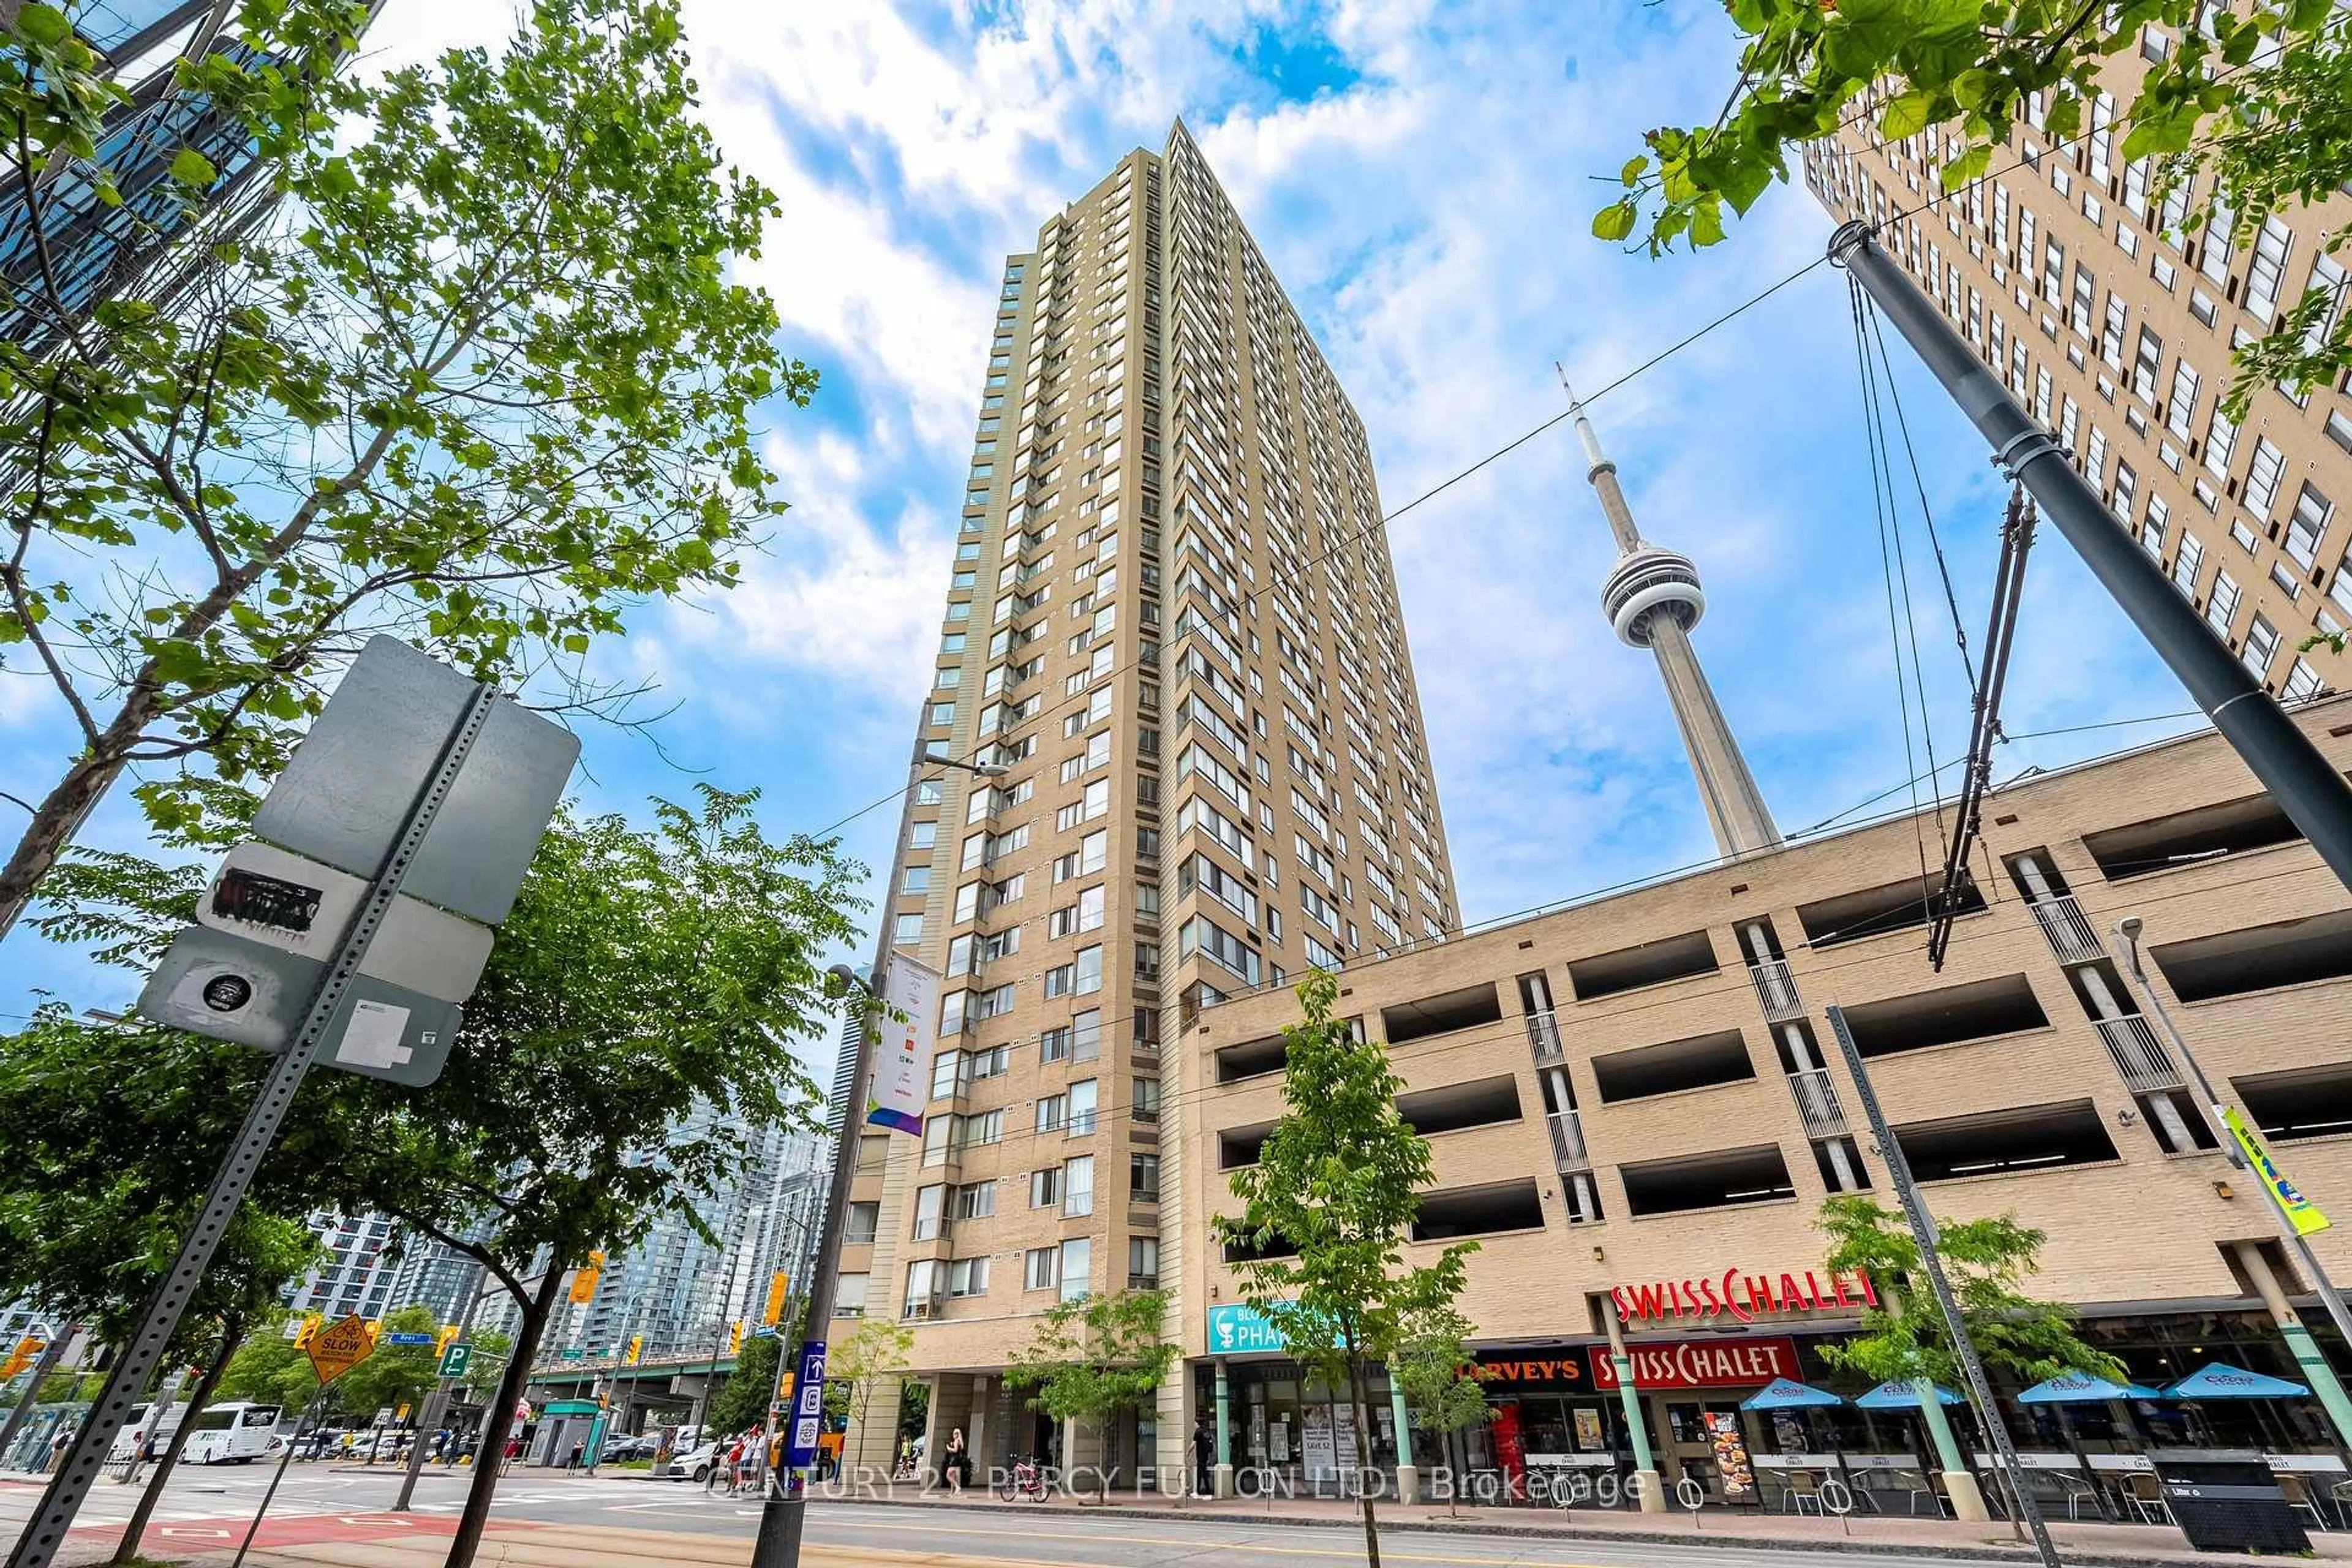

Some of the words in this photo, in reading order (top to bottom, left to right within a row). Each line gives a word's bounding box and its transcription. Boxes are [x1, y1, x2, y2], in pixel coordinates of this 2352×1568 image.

[323, 1338, 362, 1351] SLOW
[449, 1347, 464, 1364] P
[1453, 1360, 1579, 1380] ARVEY'S
